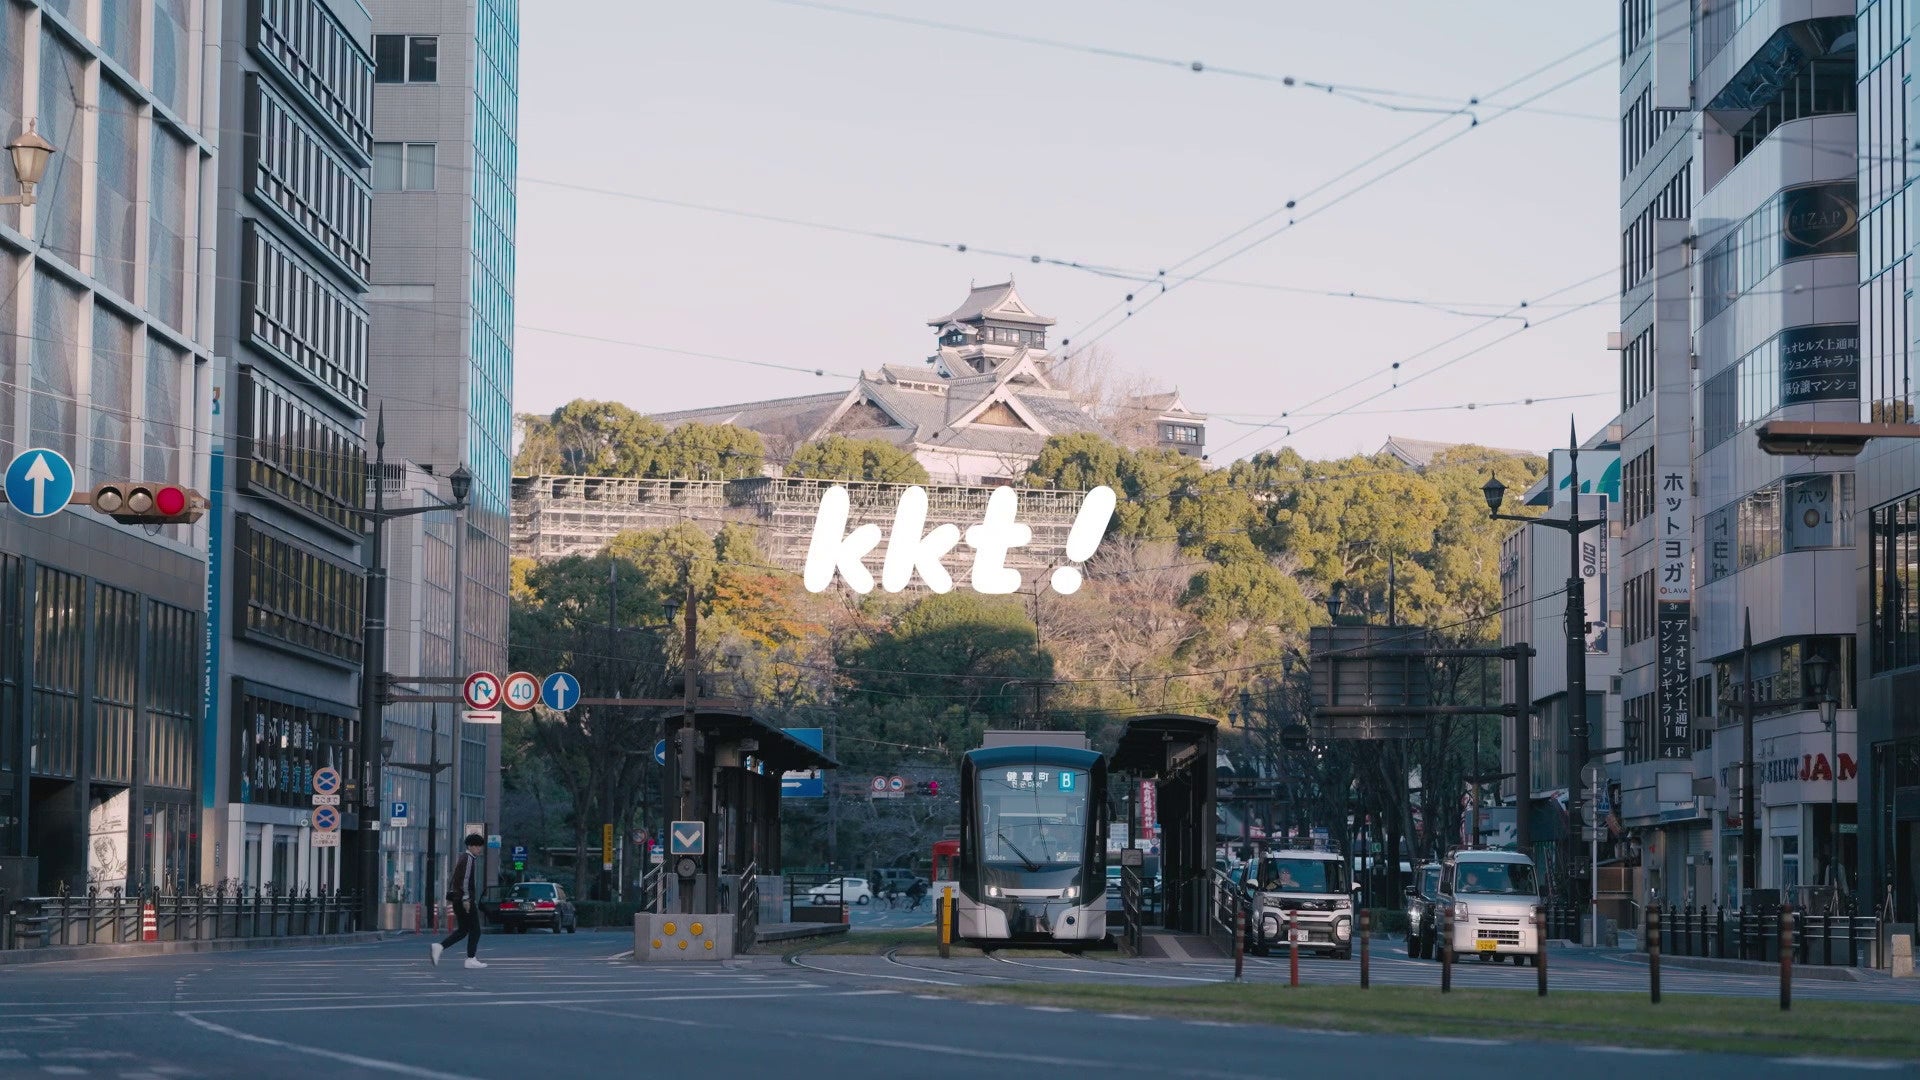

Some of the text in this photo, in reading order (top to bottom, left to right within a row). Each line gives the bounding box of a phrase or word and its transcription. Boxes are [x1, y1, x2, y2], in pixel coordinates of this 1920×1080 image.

[1663, 472, 1684, 582] ホットヨガ
[1661, 620, 1672, 739] マンションギャラリー
[1675, 619, 1688, 738] デュオヒルズ上通町
[512, 683, 531, 699] 40
[1062, 772, 1071, 787] B
[395, 803, 405, 817] P
[515, 846, 525, 855] P
